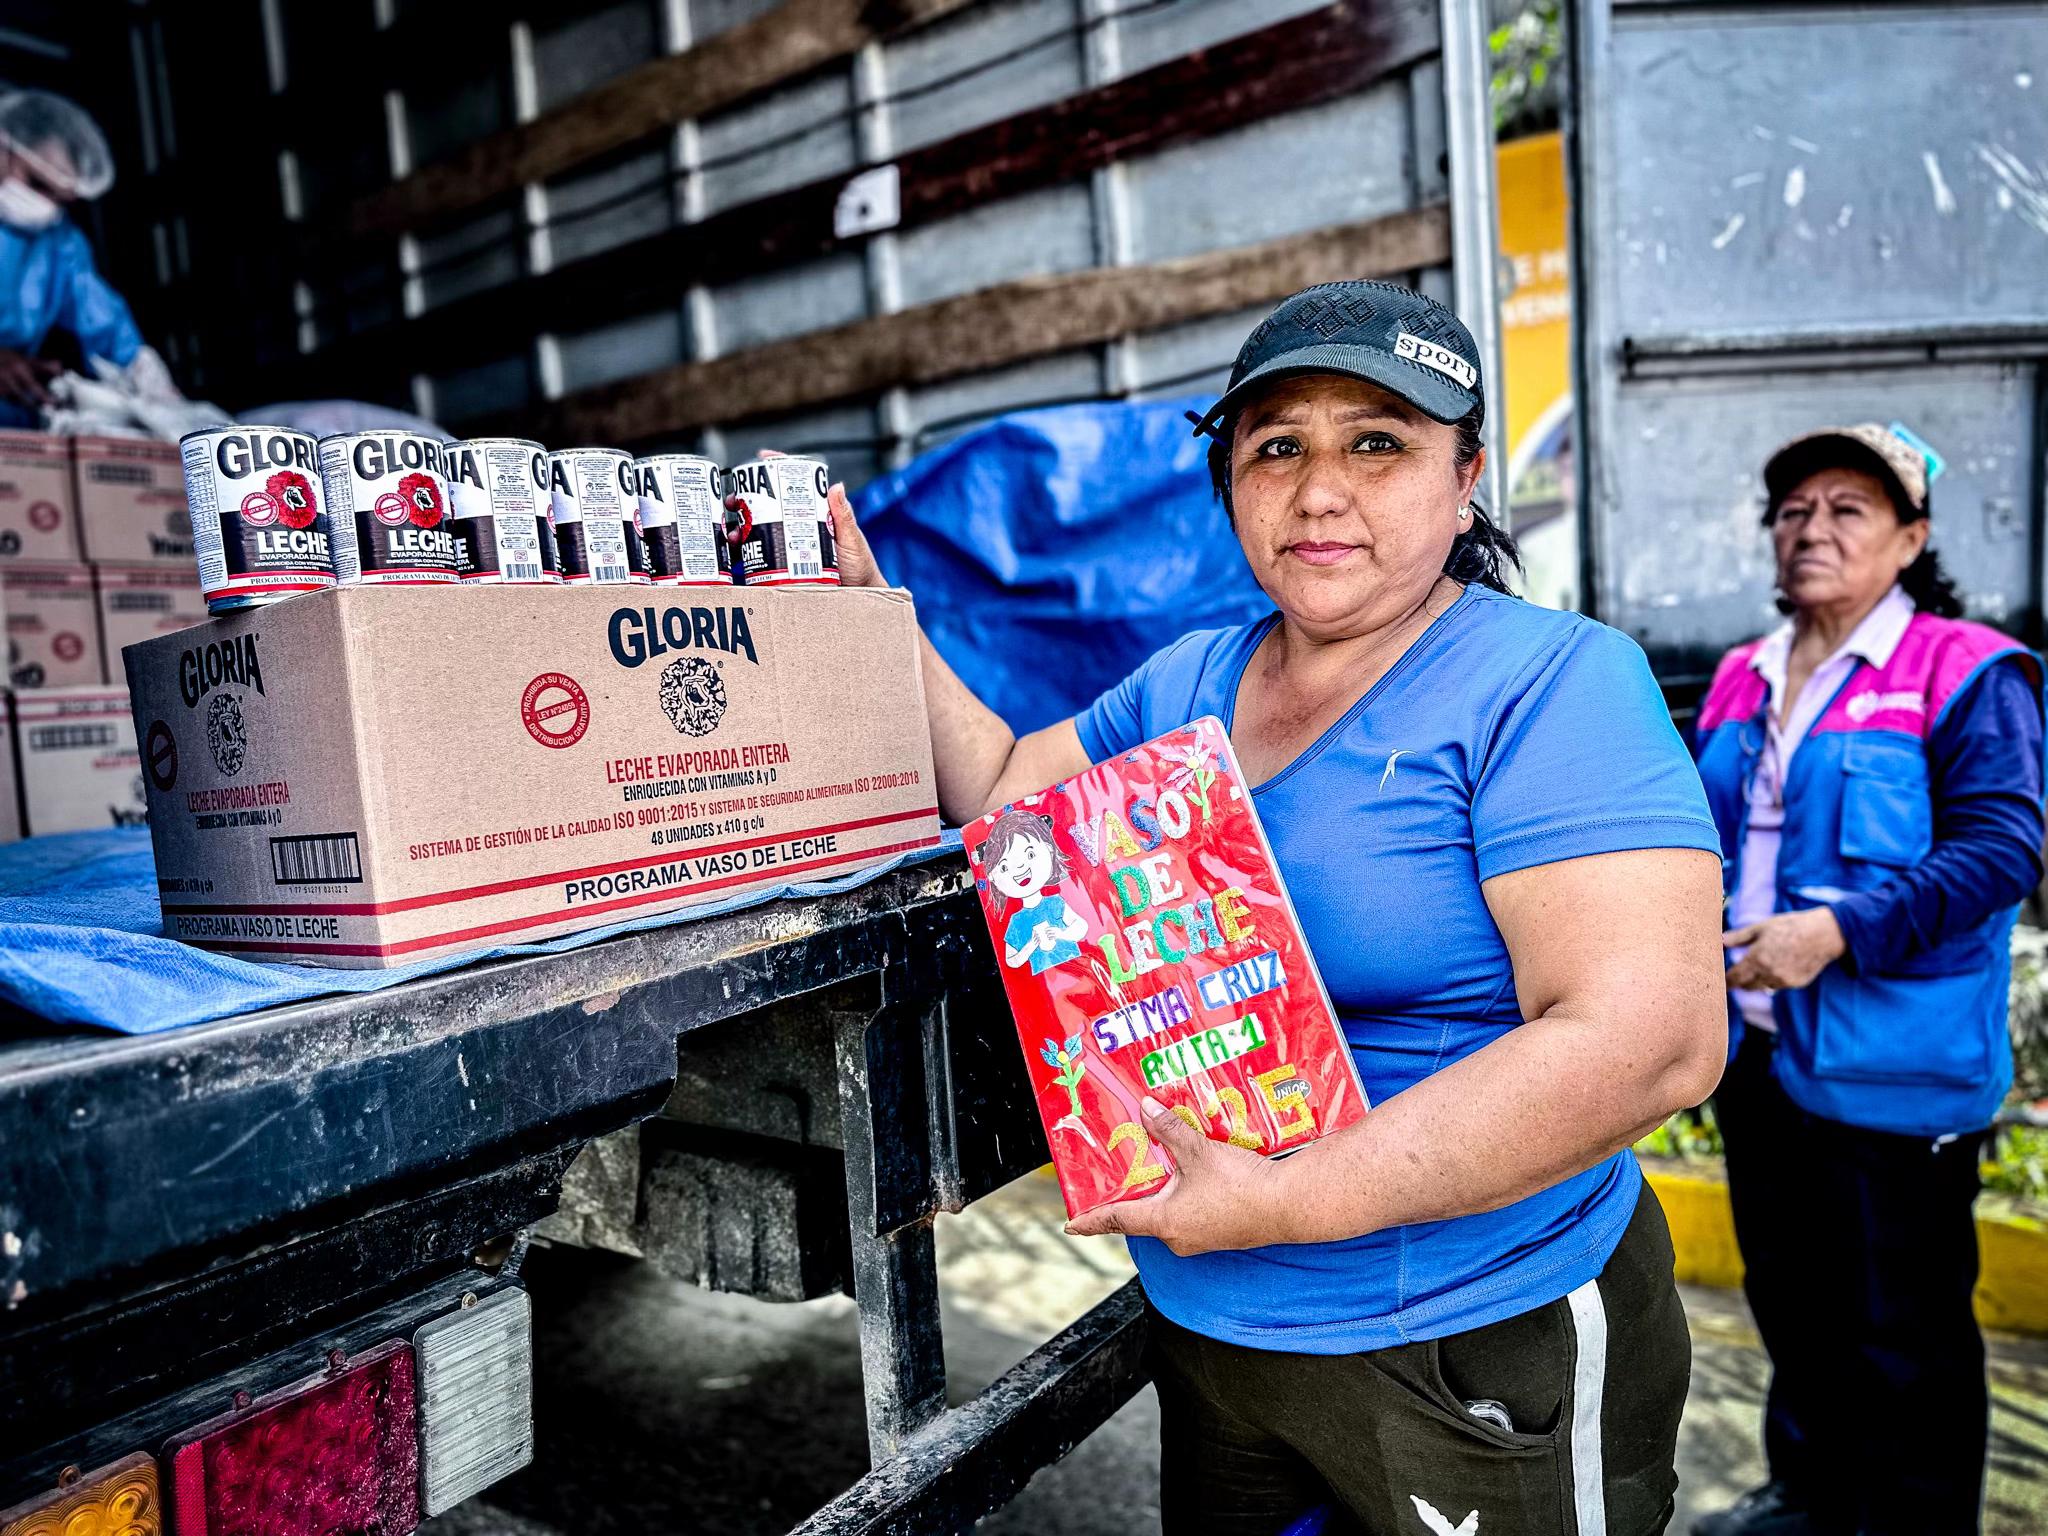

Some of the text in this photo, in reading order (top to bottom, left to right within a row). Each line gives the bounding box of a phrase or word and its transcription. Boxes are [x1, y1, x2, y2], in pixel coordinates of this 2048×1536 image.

[1399, 338, 1473, 384] sport
[353, 438, 447, 481] GLORI
[256, 530, 329, 554] LECHE
[259, 553, 309, 561] EVAPORADA
[388, 529, 454, 554] LECHE
[250, 576, 298, 585] PROGRAMA
[608, 606, 759, 669] GLORIA
[180, 633, 266, 708] GLORIA
[524, 675, 580, 713] PROHIBIDA SU VENTA
[537, 709, 550, 720] LEY
[573, 701, 588, 737] GRATUITA
[606, 742, 790, 784] LECHE EVAPORADA ENTERA
[187, 781, 291, 813] LECHE EVAPORADA ENTERA
[623, 766, 777, 802] ENRIQUECIDA CON VITAMINAS A y D
[409, 770, 920, 861] SISTEMA DE GESTIÓN DE LA CALIDAD ISO 9001:2015 Y SISTEMA DE SEGURIDAD ALIMENTARIA ISO 22000:2018
[651, 815, 764, 847] 48 UNIDADES x 410 g c/u
[1069, 790, 1192, 868] VASO
[565, 835, 837, 904] PROGRAMA VASO DE LECHE
[1109, 851, 1184, 919] DE
[177, 916, 340, 939] PROGRAMA VASO DE LECHE
[1097, 887, 1257, 986] LECHE
[1092, 951, 1288, 1054] STMA CRUZ
[1273, 1081, 1310, 1101] UNIOR
